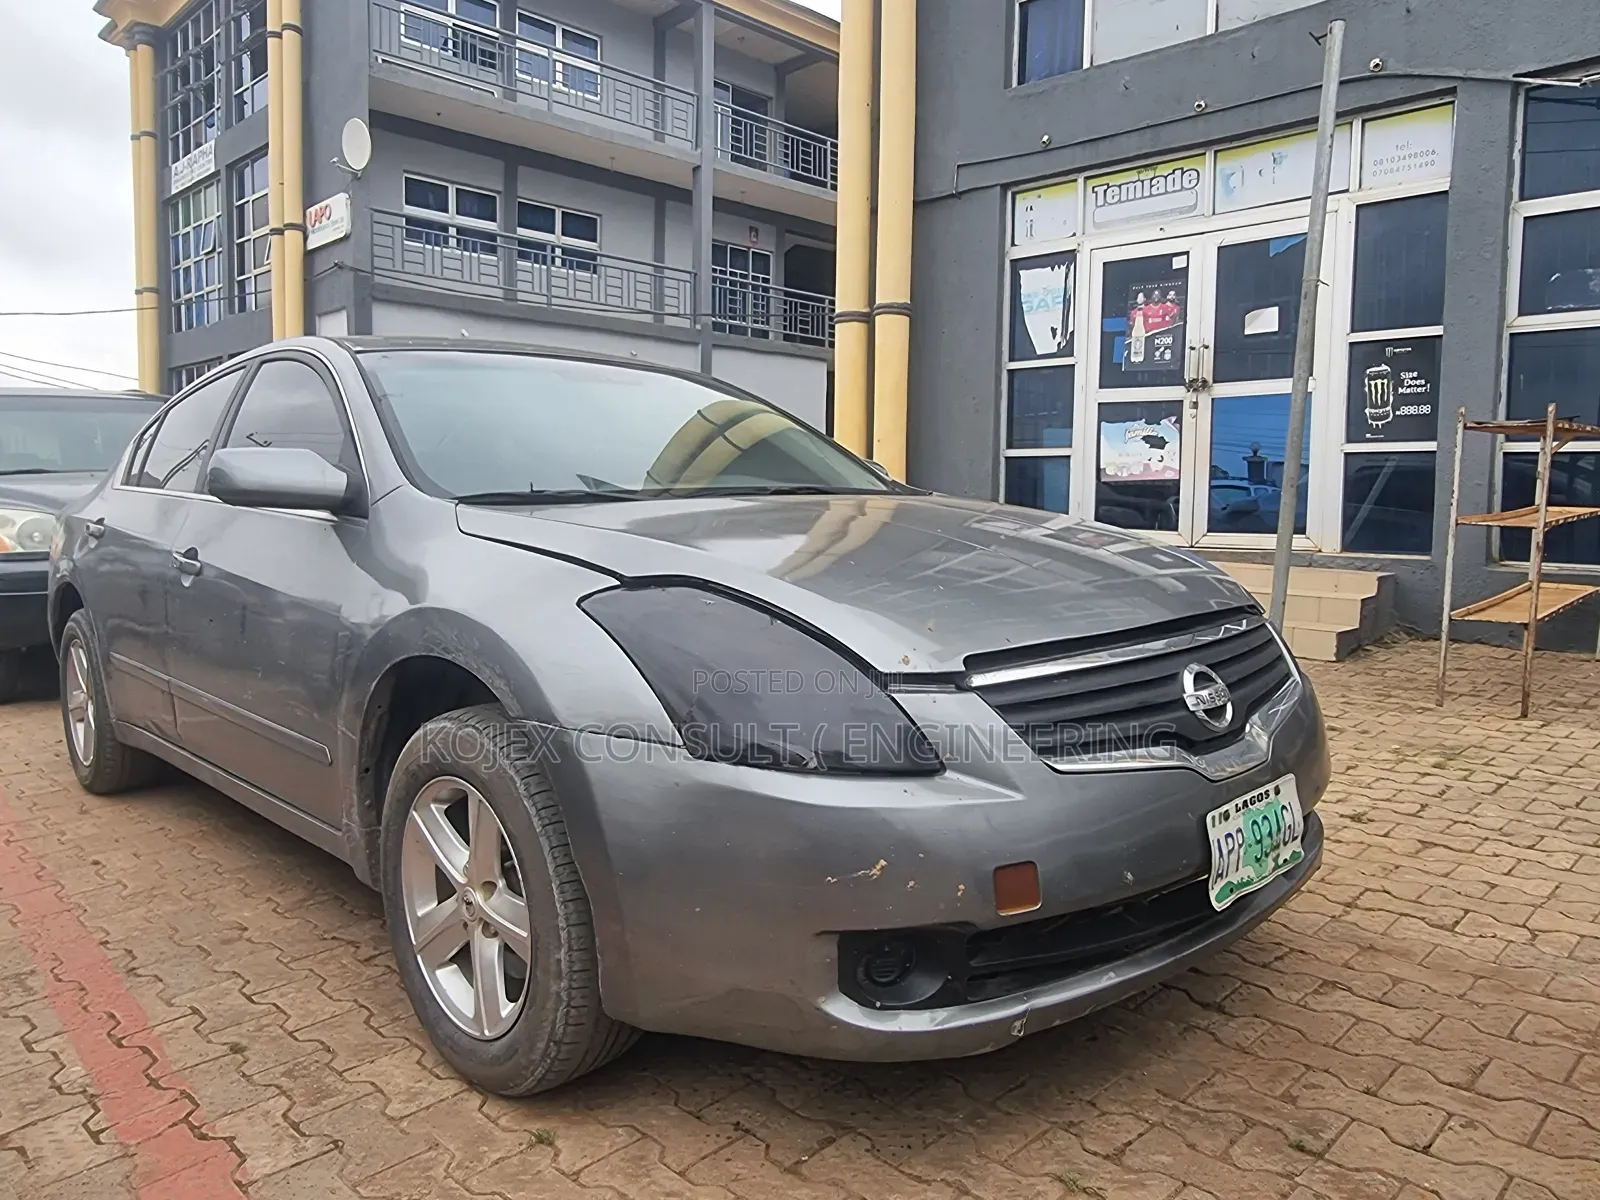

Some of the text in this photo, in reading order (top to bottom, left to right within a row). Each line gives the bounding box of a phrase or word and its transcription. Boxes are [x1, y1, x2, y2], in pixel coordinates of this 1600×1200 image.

[1395, 141, 1412, 152] tel:
[1400, 371, 1418, 380] Size
[1404, 379, 1426, 387] Does
[1235, 789, 1271, 813] LAGOS
